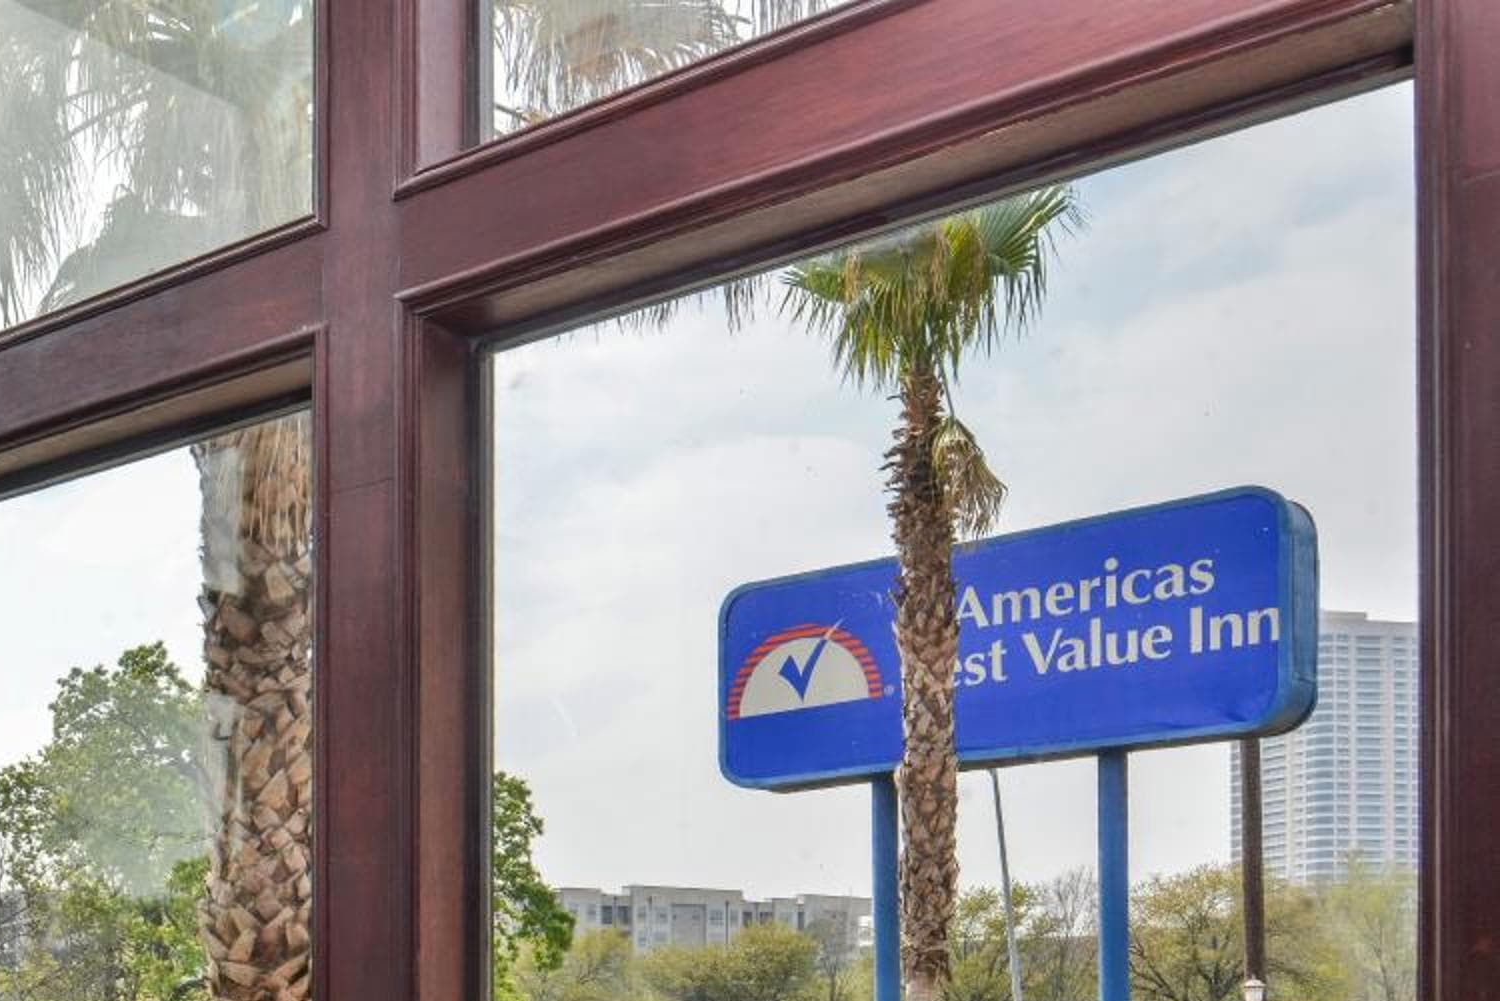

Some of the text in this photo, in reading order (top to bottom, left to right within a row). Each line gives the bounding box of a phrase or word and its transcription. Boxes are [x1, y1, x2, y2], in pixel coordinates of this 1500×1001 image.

[955, 557, 1215, 629] Americas
[953, 606, 1281, 688] st Value Inn
